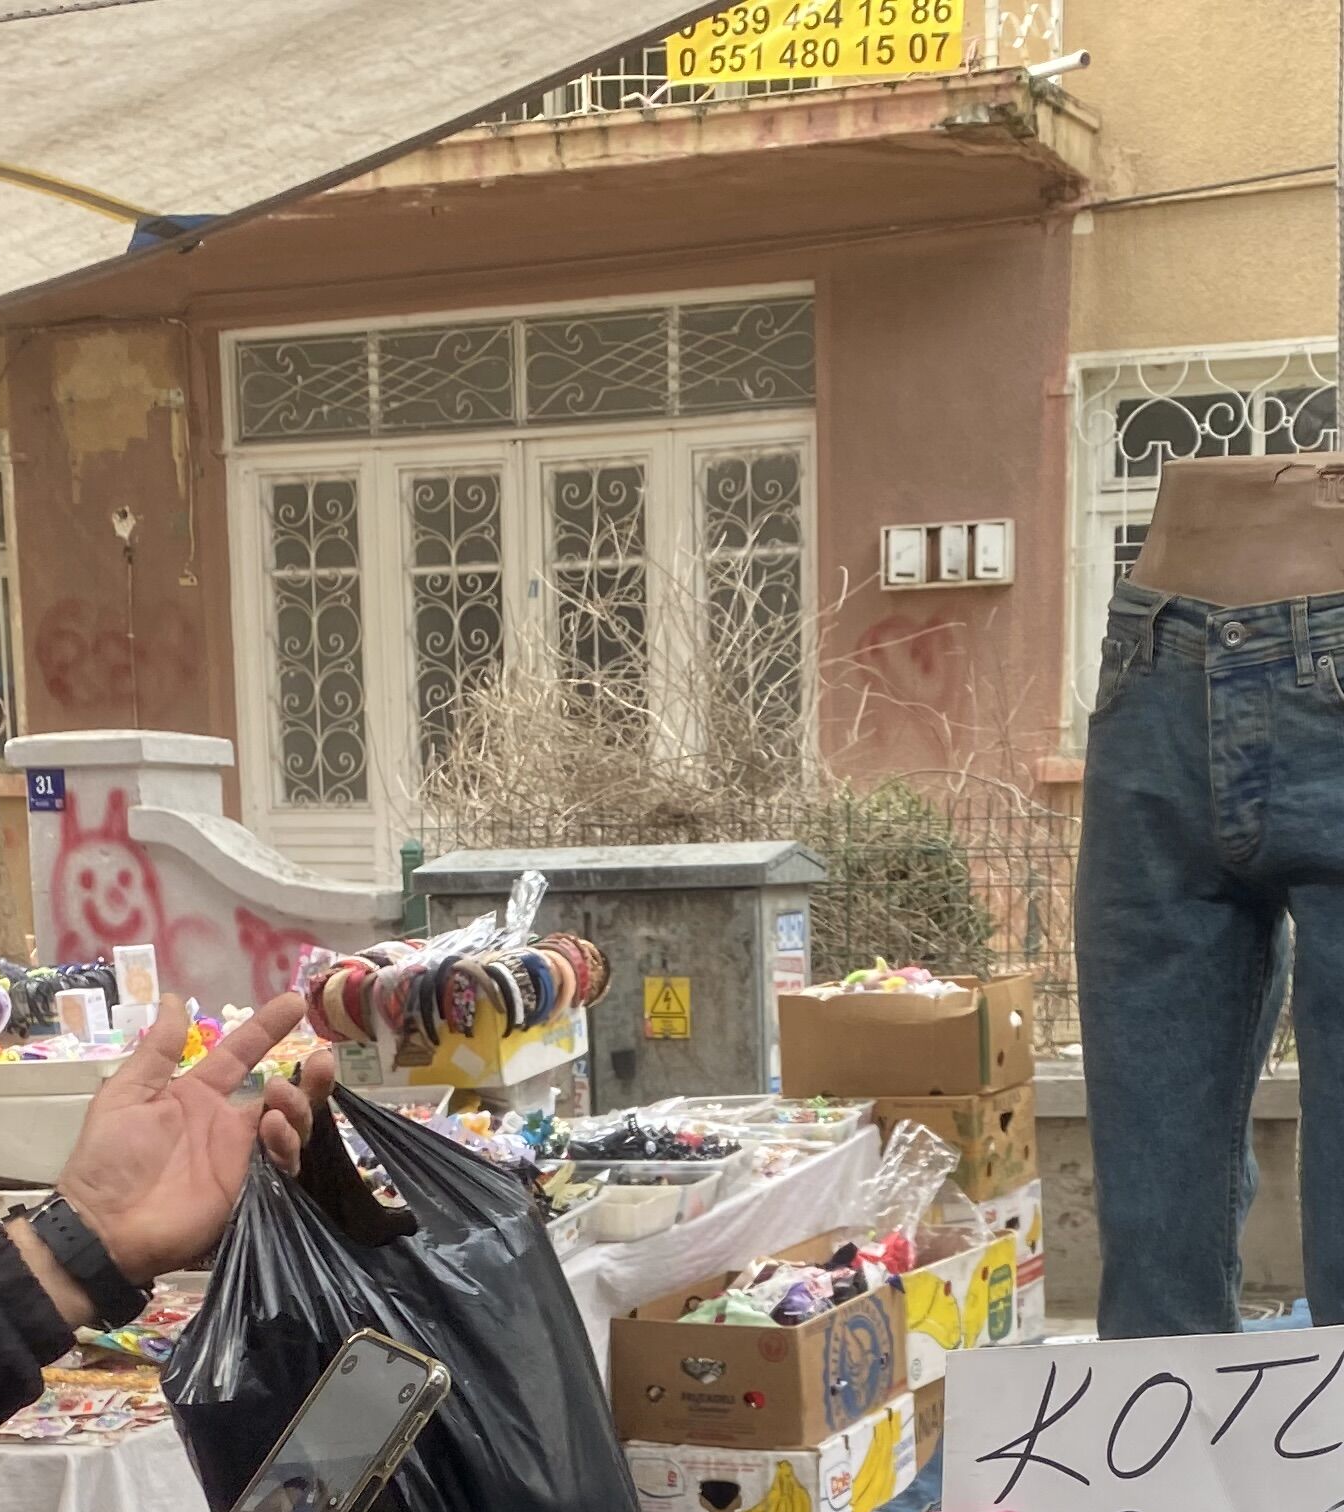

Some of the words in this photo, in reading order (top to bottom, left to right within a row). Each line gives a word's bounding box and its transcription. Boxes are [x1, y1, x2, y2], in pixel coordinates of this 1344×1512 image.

[710, 6, 771, 37] 539
[783, 2, 844, 30] 454
[857, 0, 897, 33] 15
[911, 0, 953, 25] 86
[679, 47, 696, 77] 0
[709, 45, 764, 75] 551
[779, 38, 840, 69] 480
[855, 35, 896, 66] 15
[908, 31, 950, 64] 07
[35, 775, 55, 795] 31
